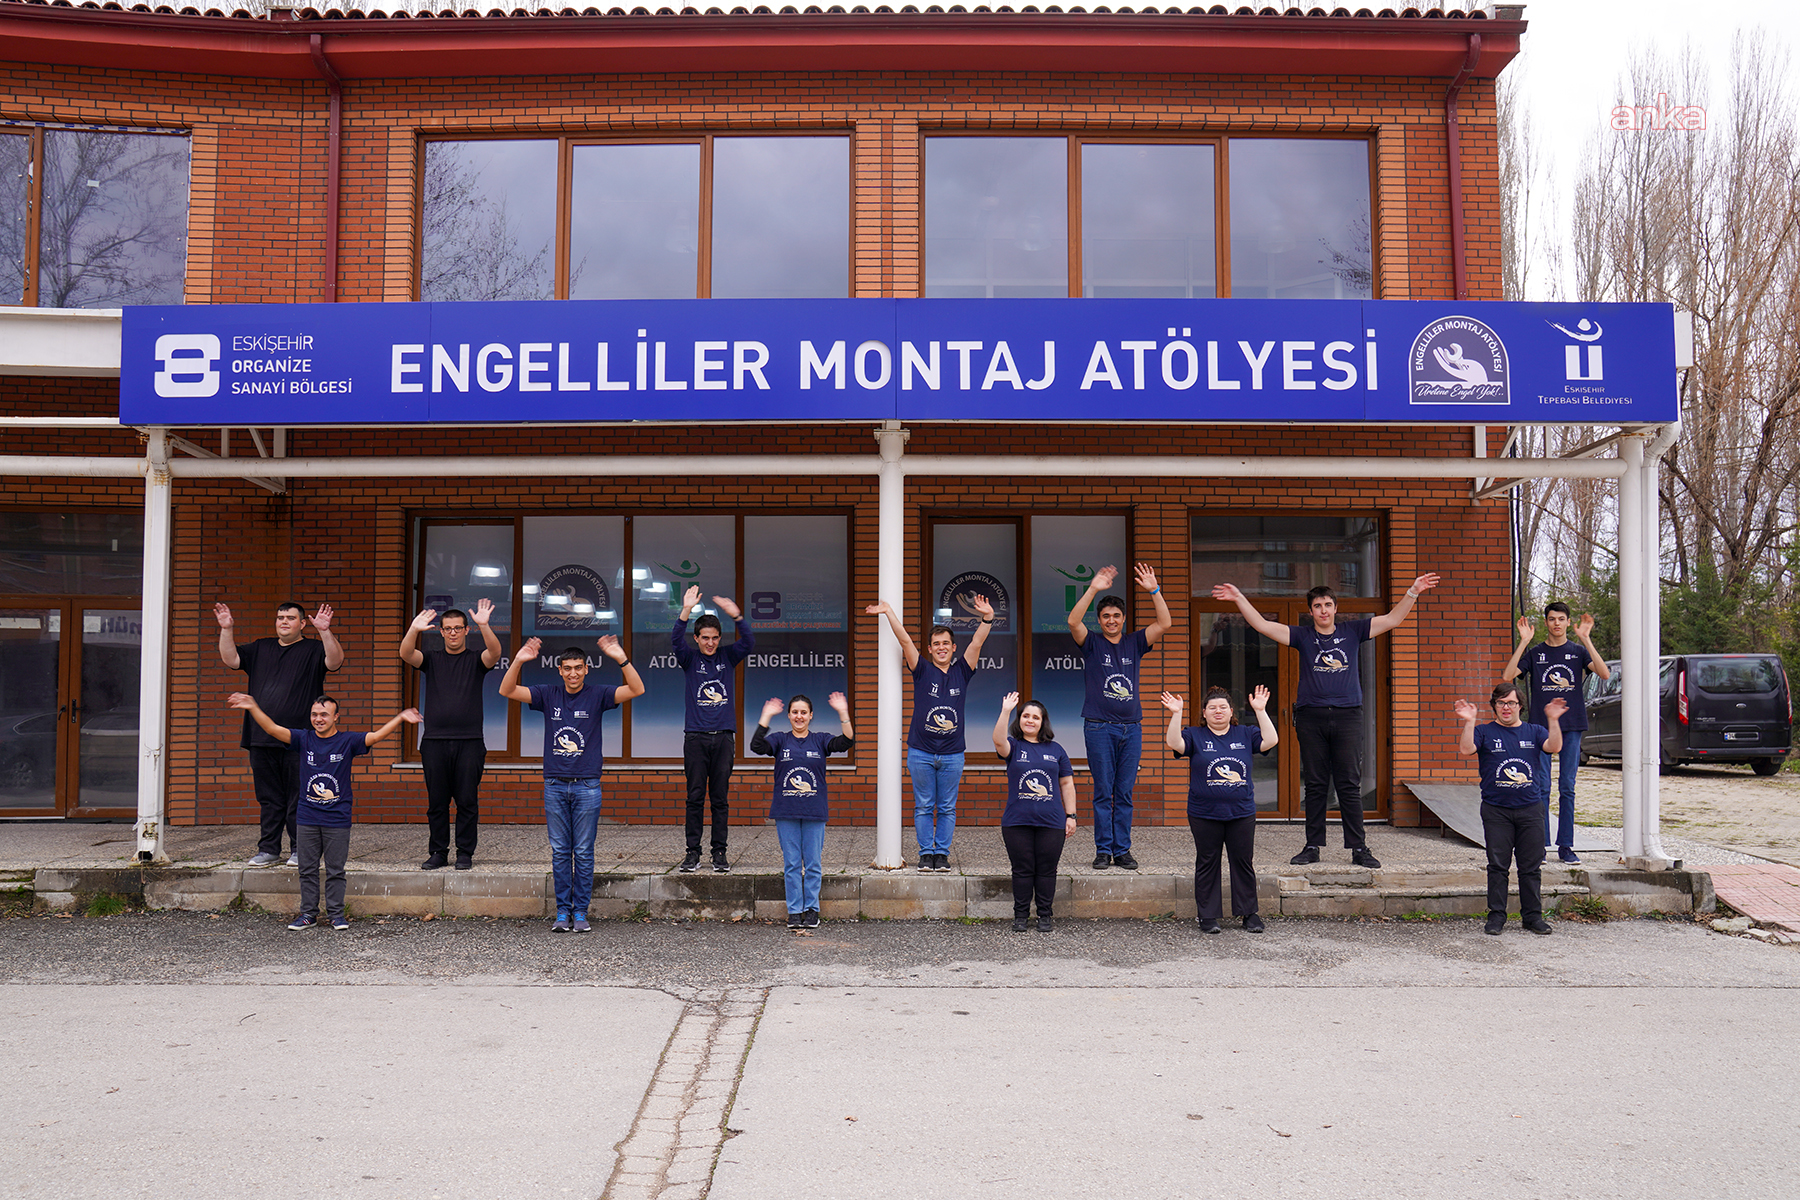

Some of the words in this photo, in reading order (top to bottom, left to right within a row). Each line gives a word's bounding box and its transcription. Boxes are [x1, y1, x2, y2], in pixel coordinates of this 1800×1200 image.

[232, 332, 314, 354] ESKİŞEHİR
[1415, 324, 1445, 371] ENGELLİLER
[1444, 320, 1483, 335] MONTAJ
[1481, 332, 1504, 373] ATÖLYESİ
[231, 356, 312, 373] ORGANİZE
[391, 328, 771, 393] ENGELLİLER
[800, 339, 1056, 391] MONTAJ
[1080, 327, 1378, 391] ATÖLYESİ
[231, 378, 285, 394] SANAYİ
[290, 377, 352, 394] BÖLGESİ
[1450, 385, 1476, 400] Engel
[562, 567, 592, 579] MONTAJ
[964, 574, 993, 584] MONTAJ
[747, 651, 845, 668] ENGELLİLER
